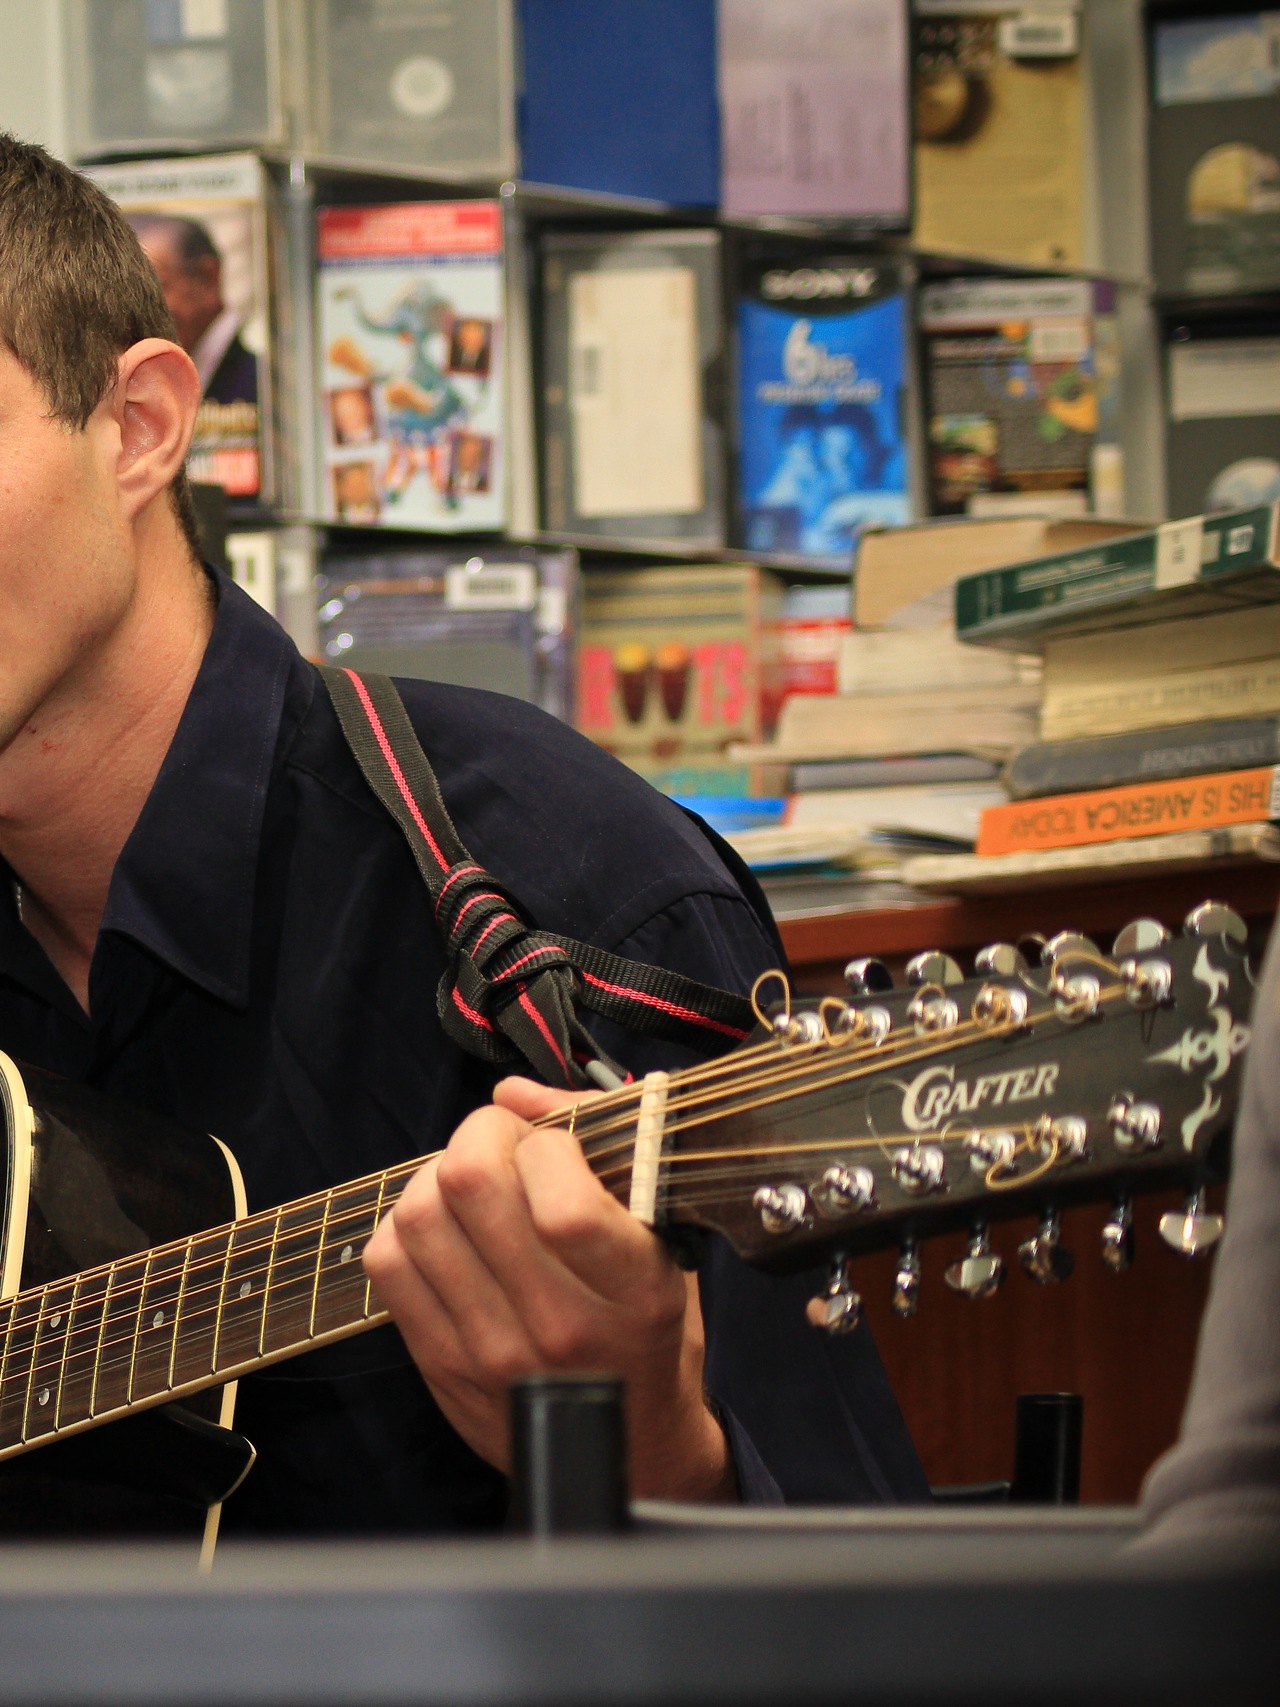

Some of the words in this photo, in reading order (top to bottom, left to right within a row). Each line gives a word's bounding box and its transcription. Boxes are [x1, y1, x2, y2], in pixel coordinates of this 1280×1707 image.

[761, 267, 878, 300] SONY
[1086, 789, 1197, 832] AMERICA
[1202, 784, 1222, 818] IS
[1008, 806, 1077, 840] TODAY
